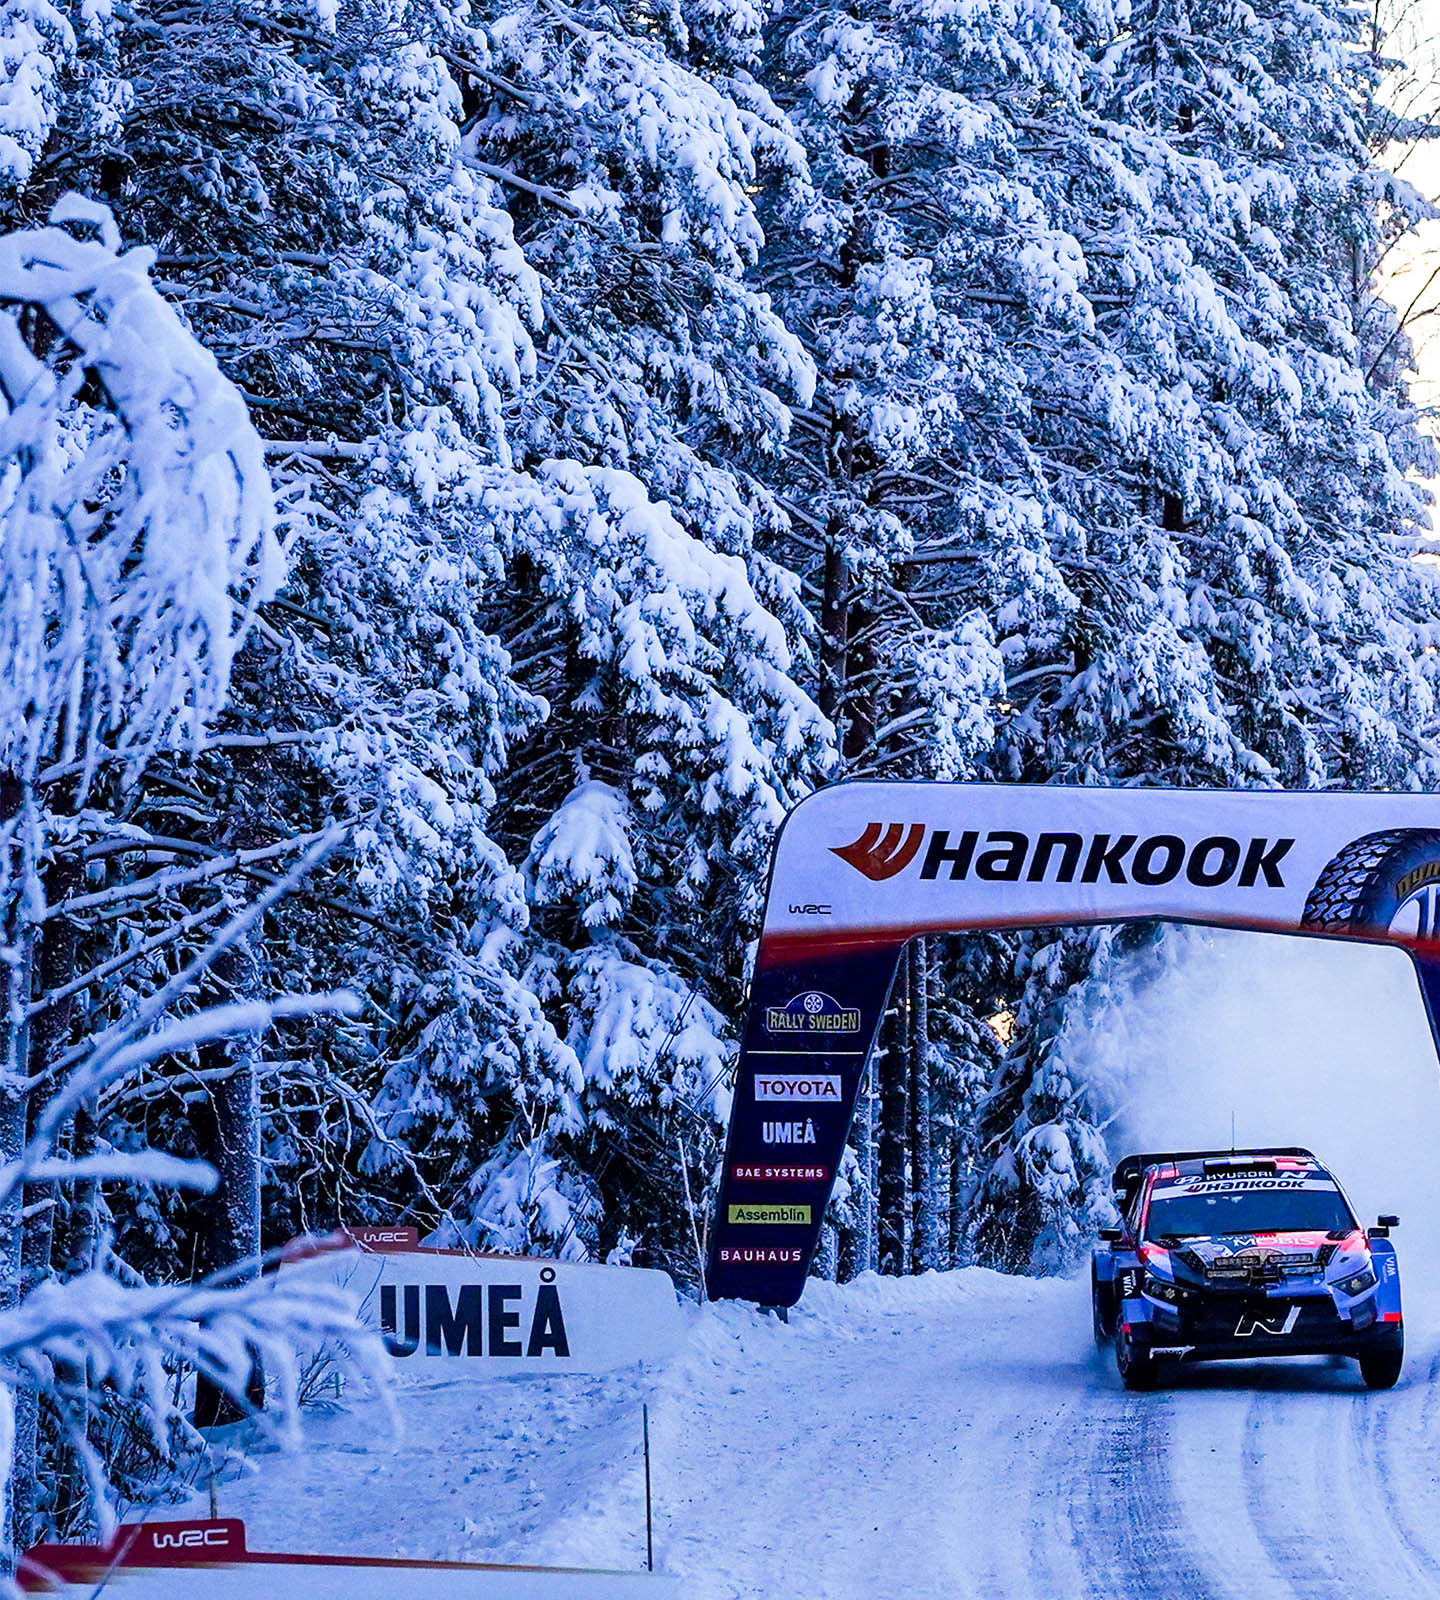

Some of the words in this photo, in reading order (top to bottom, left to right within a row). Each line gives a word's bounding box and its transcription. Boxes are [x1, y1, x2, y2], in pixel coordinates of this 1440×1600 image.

[770, 1012, 804, 1029] RALLY
[808, 1013, 857, 1030] SWEDEN
[760, 1080, 837, 1096] TOYOTA
[762, 1117, 816, 1144] UMEÅ
[736, 1168, 761, 1177] BAE
[765, 1168, 824, 1178] SYSTEMS
[735, 1208, 805, 1221] Assemblin
[364, 1231, 409, 1242] WRC
[720, 1250, 802, 1262] BAUHAUS
[380, 1267, 571, 1358] UMEÅ
[153, 1528, 229, 1548] WRC
